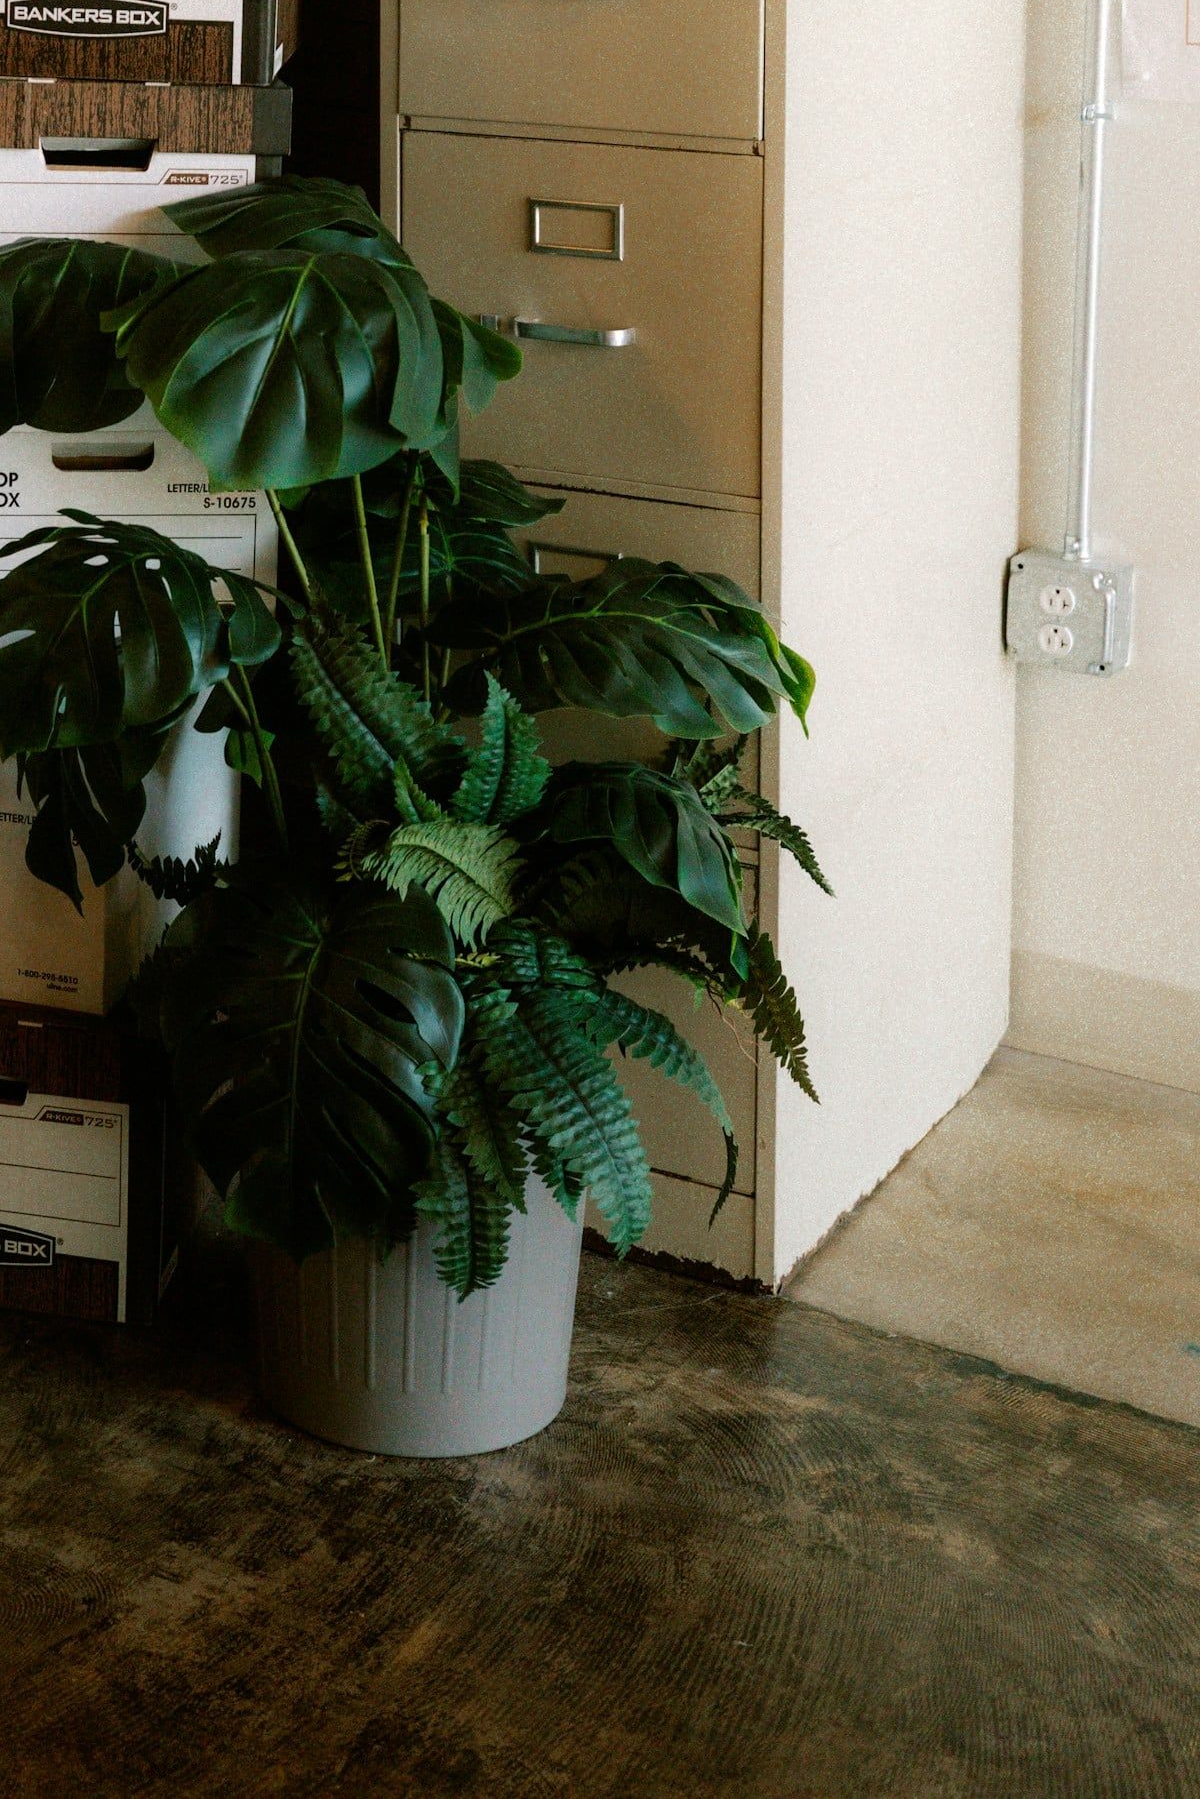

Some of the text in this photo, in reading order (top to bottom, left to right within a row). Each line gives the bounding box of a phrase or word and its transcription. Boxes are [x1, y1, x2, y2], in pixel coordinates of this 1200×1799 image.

[14, 6, 161, 26] BANKERS BOX
[203, 497, 256, 509] S-10675
[4, 1239, 48, 1258] BOX
